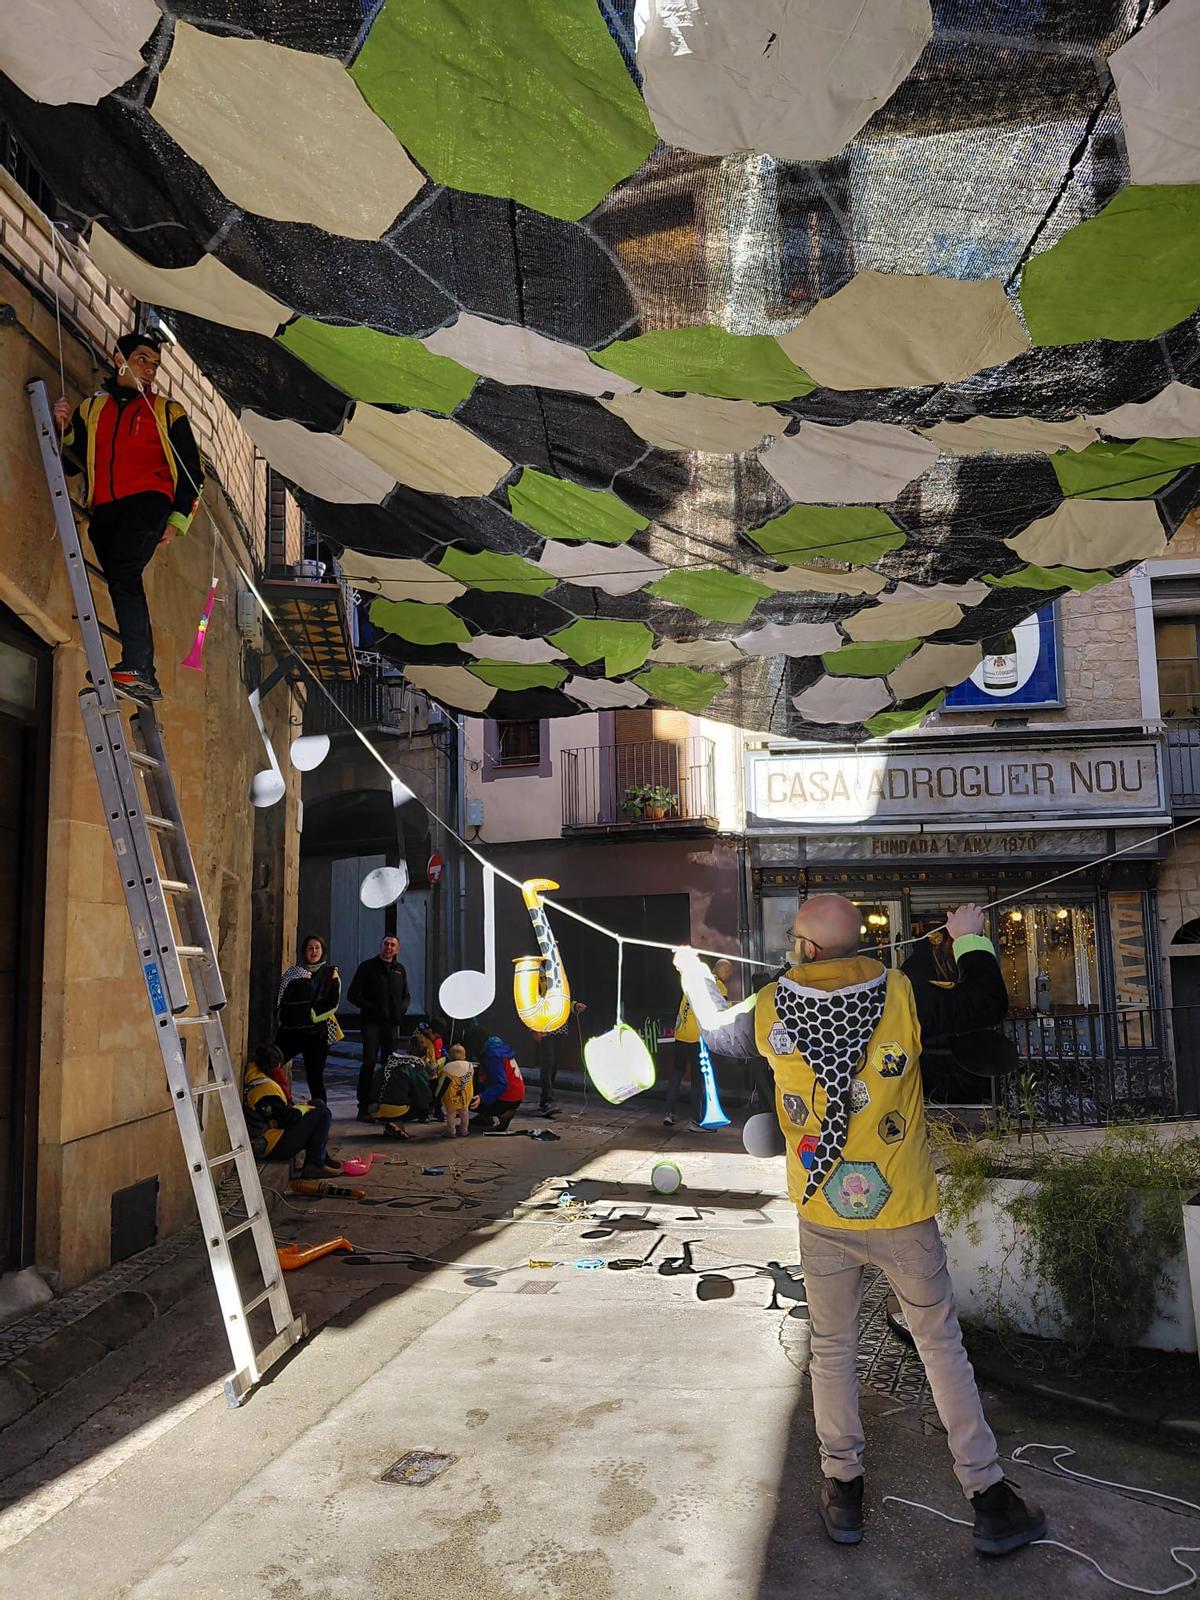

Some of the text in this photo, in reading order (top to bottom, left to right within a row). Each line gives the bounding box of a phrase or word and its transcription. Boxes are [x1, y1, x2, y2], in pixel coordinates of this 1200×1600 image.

[767, 760, 1143, 803] CASA ADROGUER NOU
[872, 838, 940, 855] FUNDADA
[1000, 836, 1036, 852] 1870
